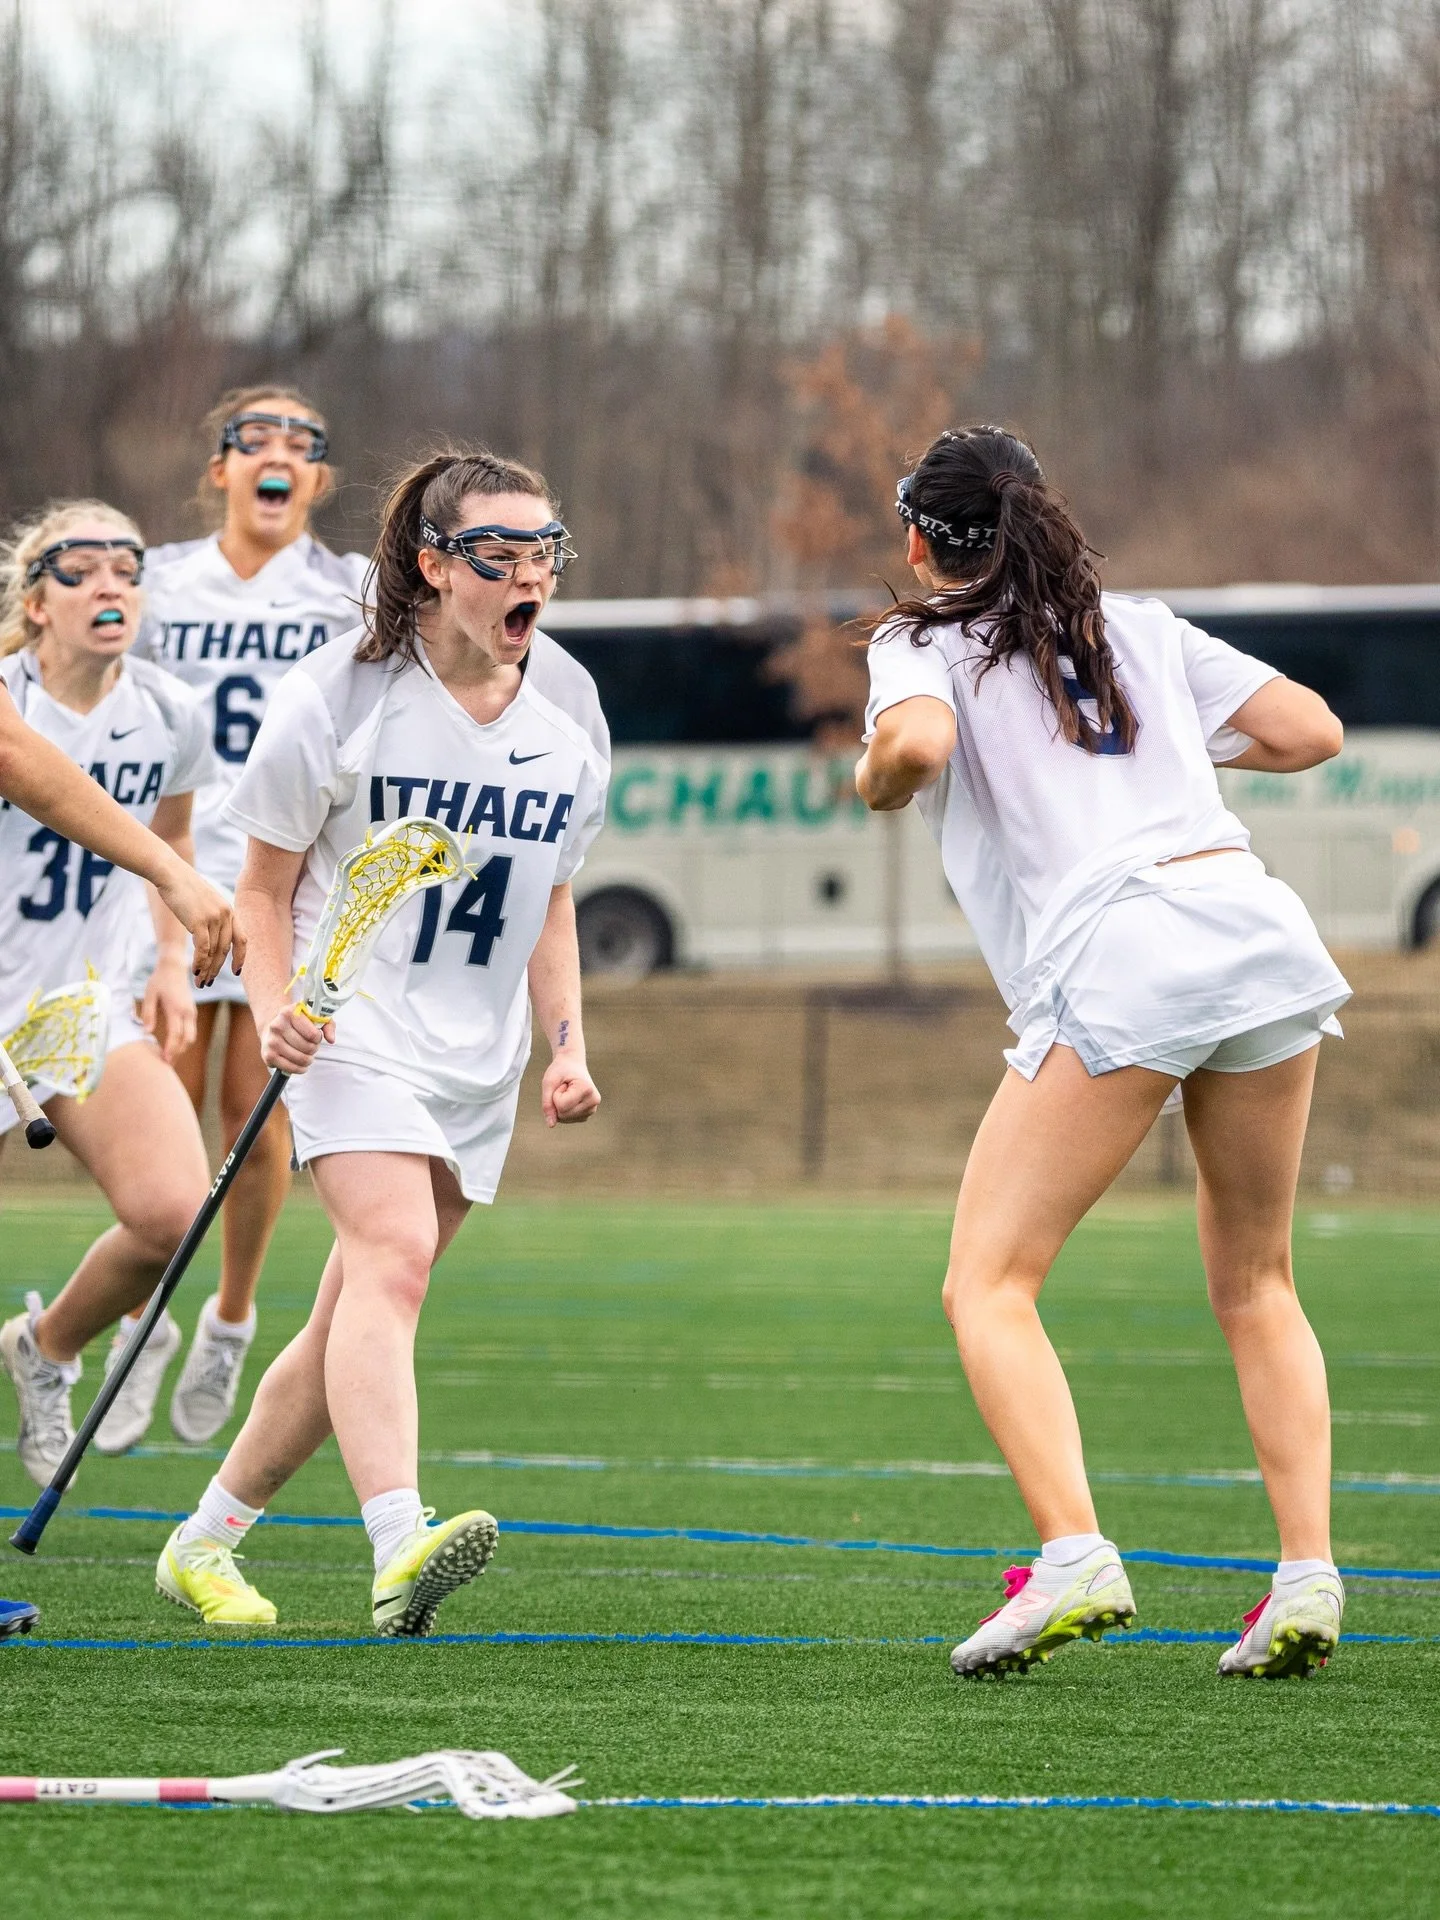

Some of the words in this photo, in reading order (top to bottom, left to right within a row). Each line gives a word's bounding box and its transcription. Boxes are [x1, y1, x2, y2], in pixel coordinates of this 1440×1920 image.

[422, 526, 442, 548] STX
[898, 501, 913, 519] TX
[919, 513, 953, 535] STX
[967, 527, 998, 539] ST
[215, 675, 263, 764] 6
[370, 775, 575, 844] ITHACA
[409, 851, 516, 968] 14
